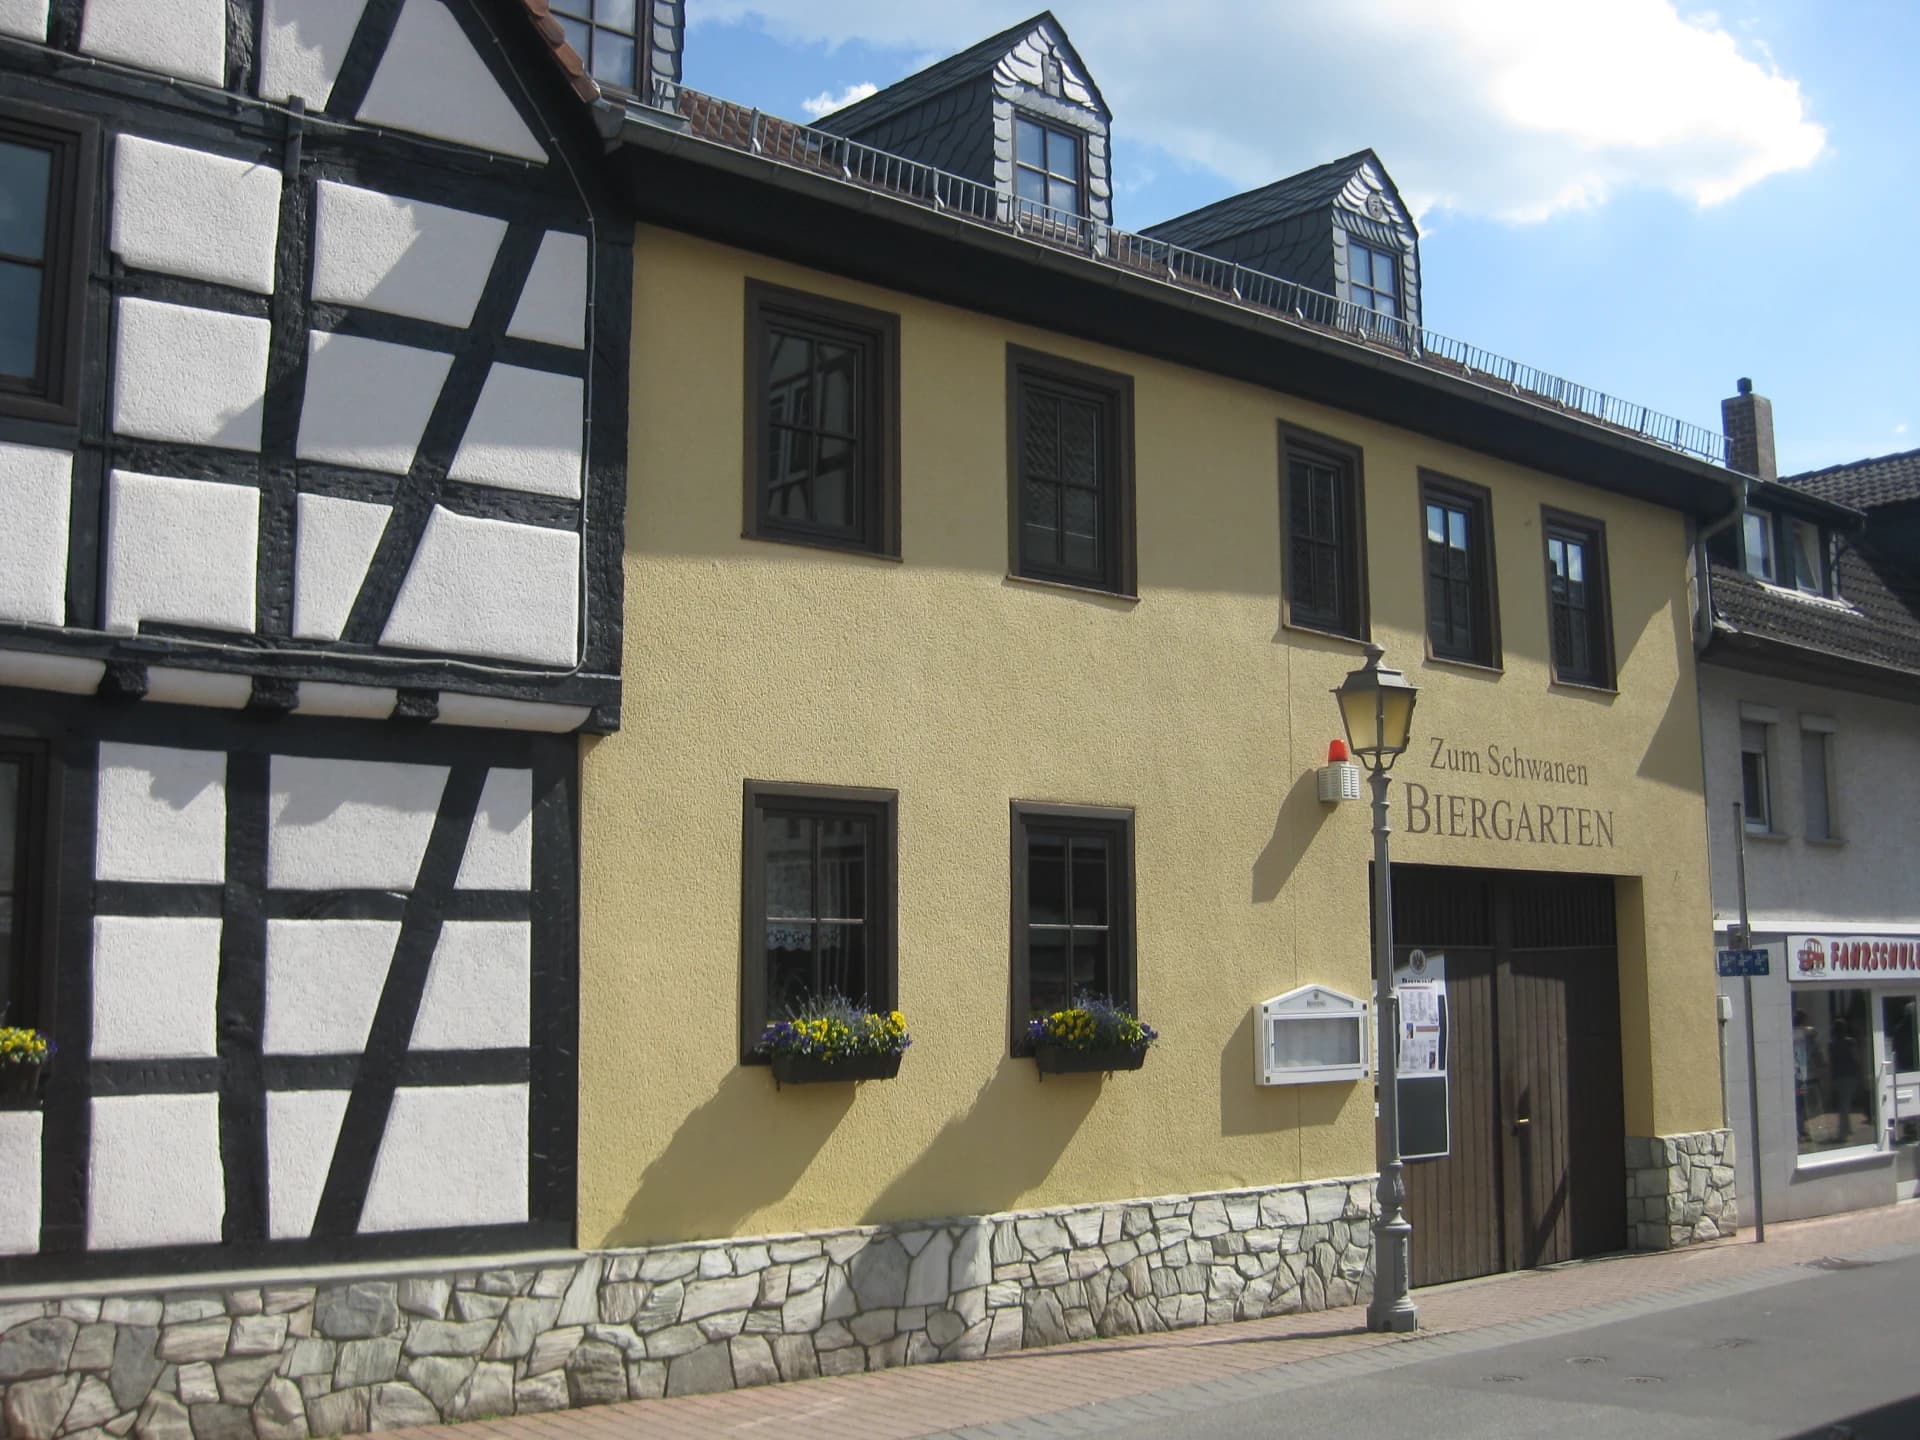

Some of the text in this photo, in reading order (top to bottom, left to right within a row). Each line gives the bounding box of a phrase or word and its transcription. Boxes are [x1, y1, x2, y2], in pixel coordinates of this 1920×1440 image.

[1430, 737, 1588, 786] Zum Schwanen
[1403, 781, 1614, 849] BIERGARTEN
